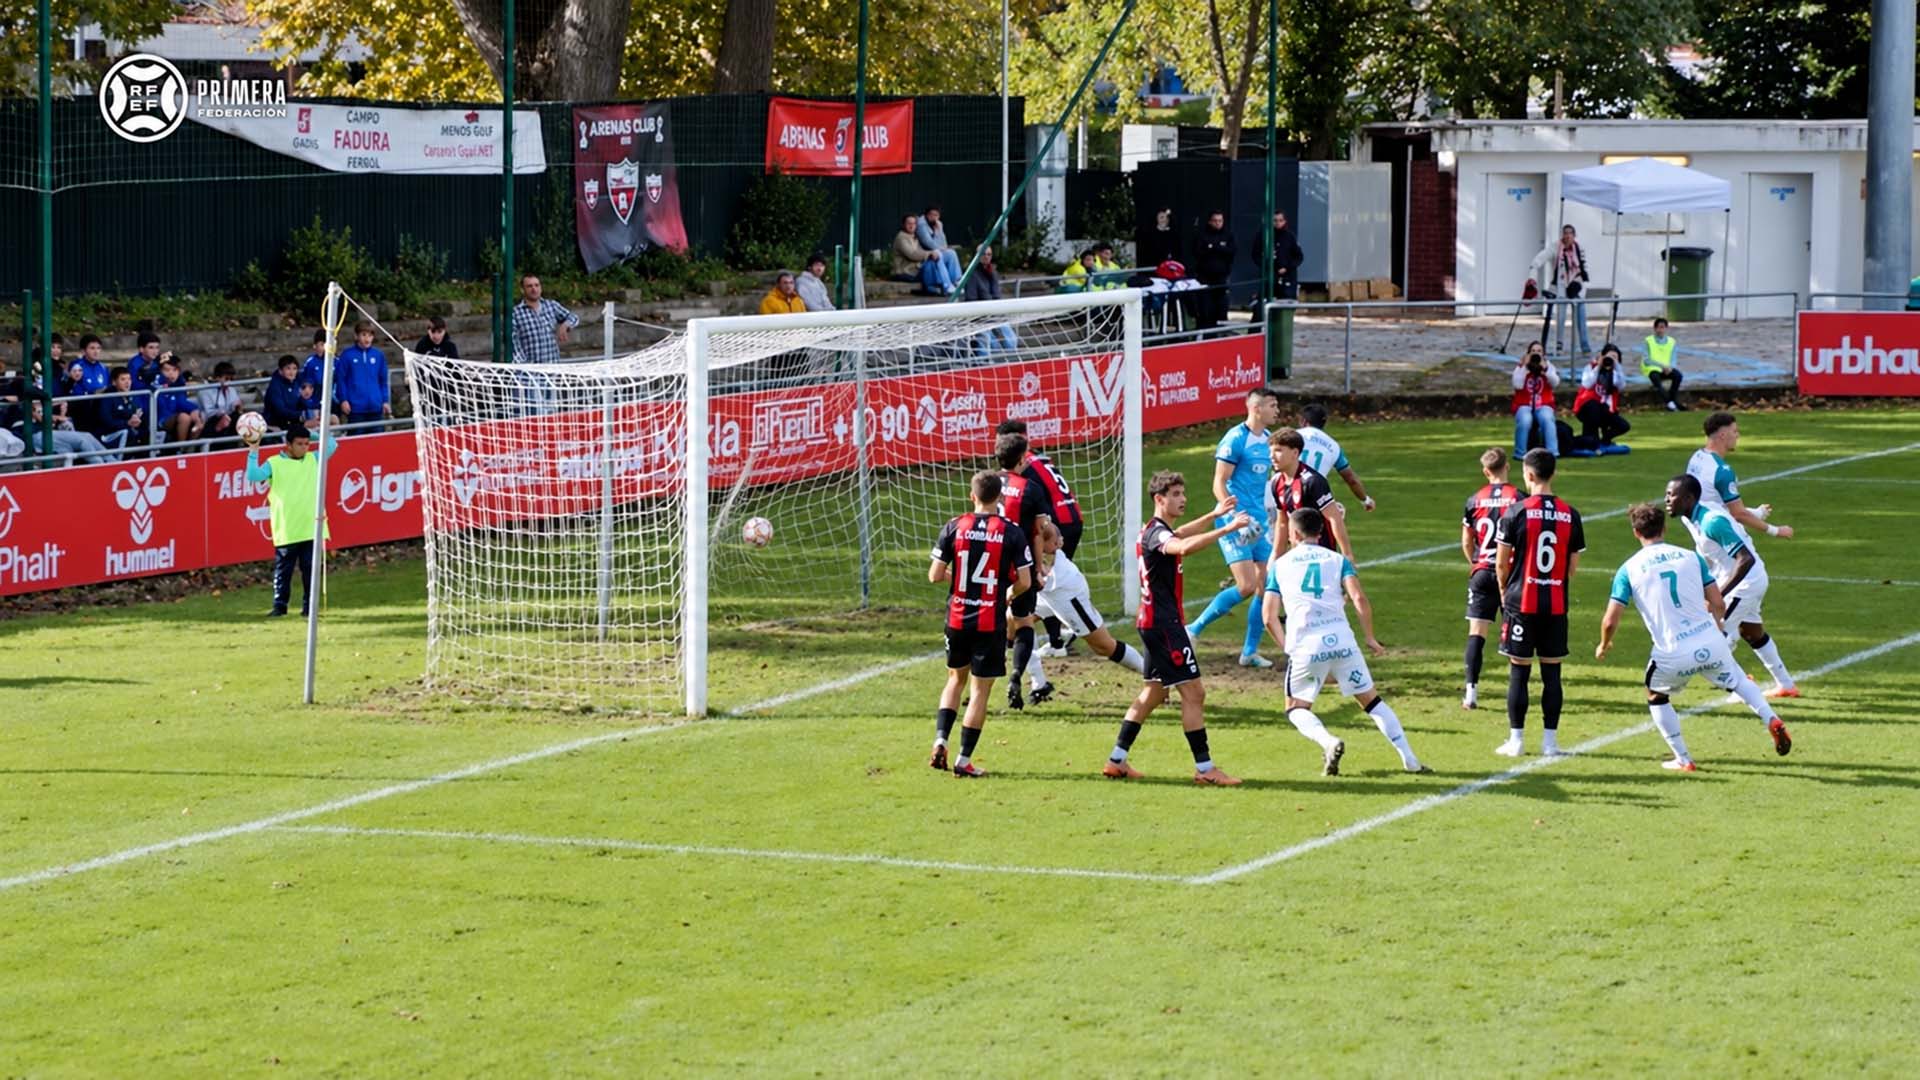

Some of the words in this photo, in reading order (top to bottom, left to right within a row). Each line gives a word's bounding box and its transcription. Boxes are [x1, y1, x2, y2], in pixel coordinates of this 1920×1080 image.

[346, 110, 380, 124] CAMPO
[440, 125, 471, 137] MENOS
[473, 126, 494, 137] GOLF
[589, 119, 632, 137] ARENAS
[633, 117, 656, 133] CLUB
[334, 129, 391, 151] FADURA
[1044, 463, 1070, 495] 5
[105, 538, 176, 576] hummel
[1536, 530, 1558, 574] 6
[957, 549, 998, 594] 14
[1300, 562, 1325, 600] 4
[1658, 570, 1682, 609] 7
[1183, 646, 1195, 665] 2
